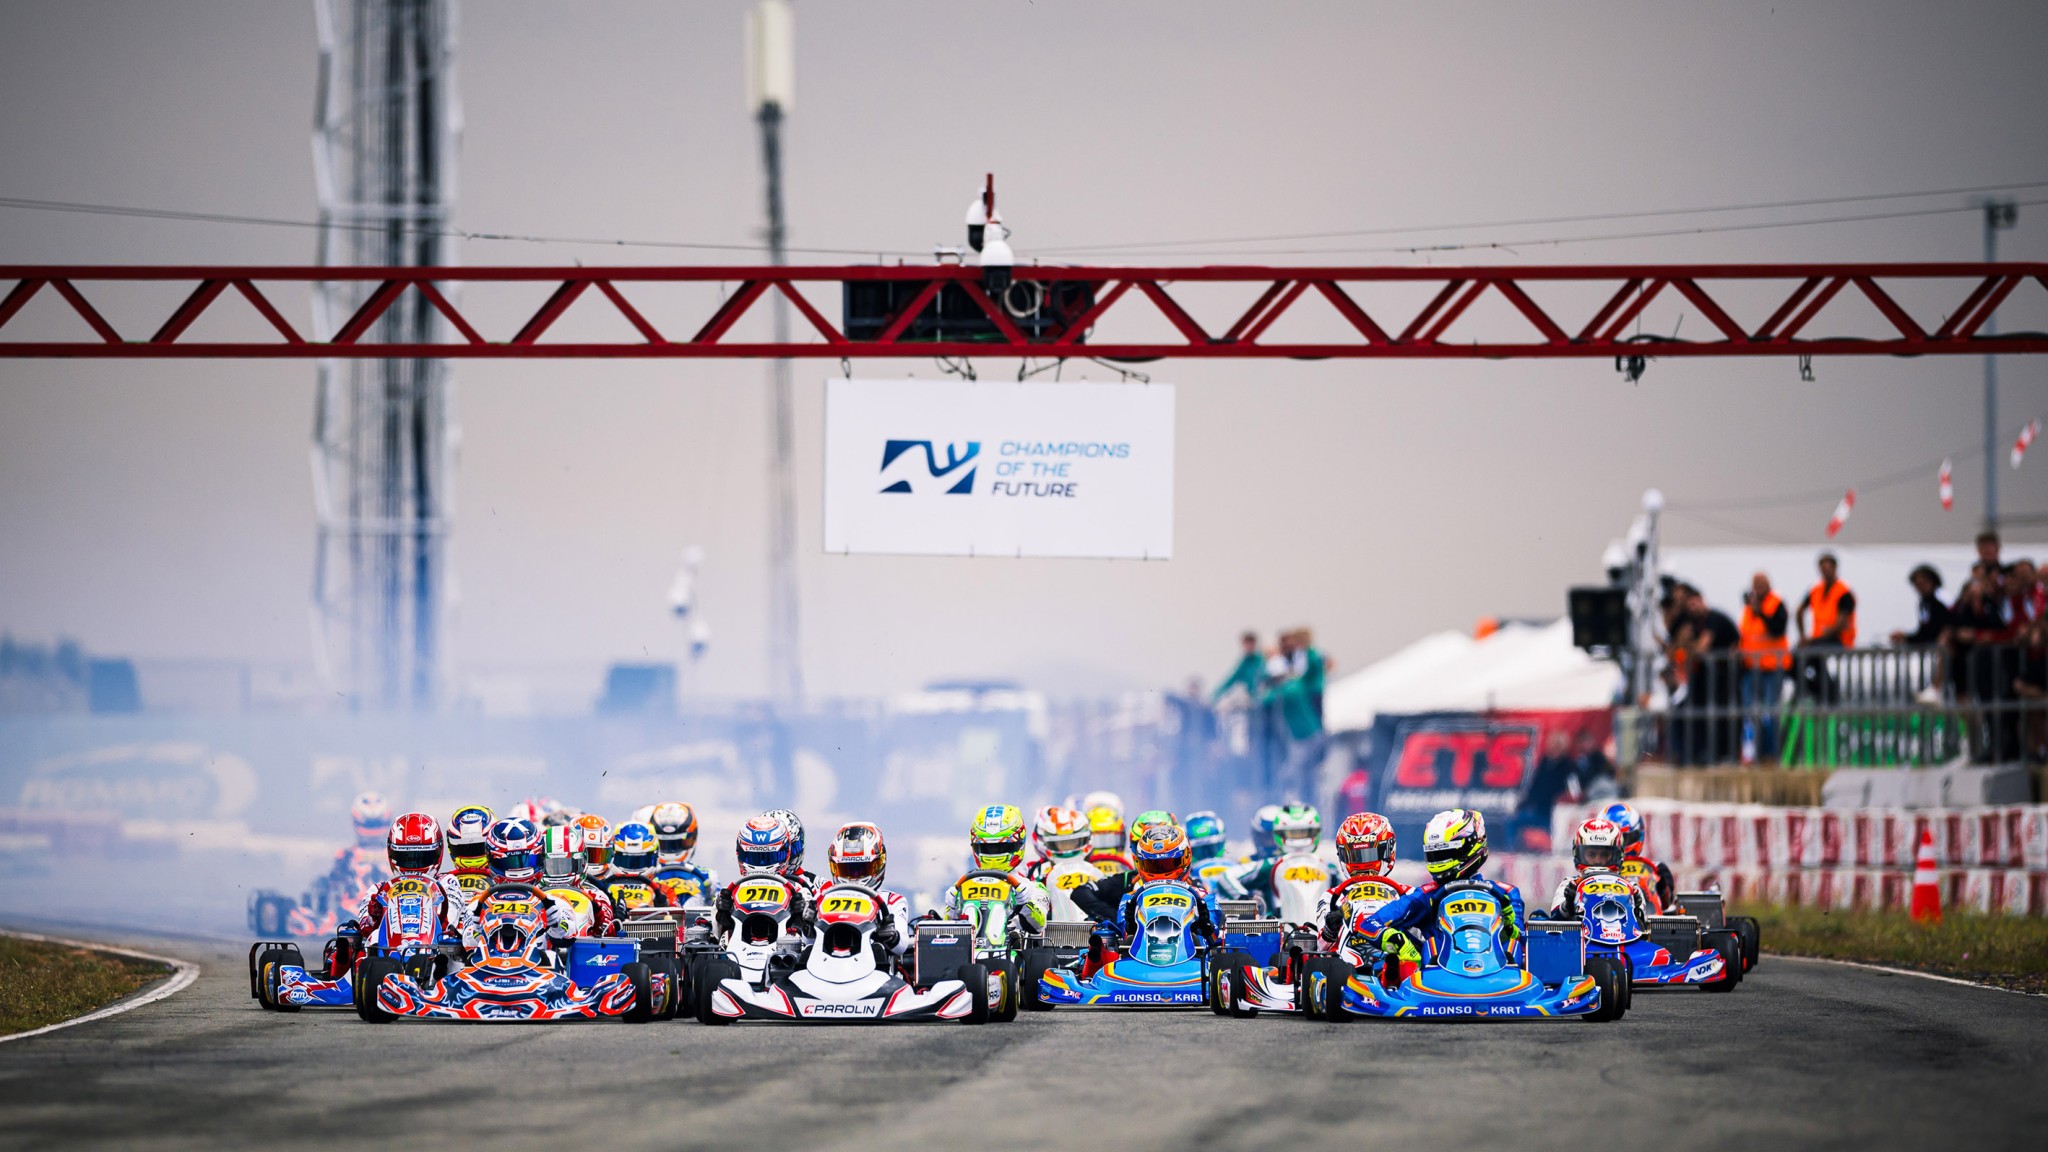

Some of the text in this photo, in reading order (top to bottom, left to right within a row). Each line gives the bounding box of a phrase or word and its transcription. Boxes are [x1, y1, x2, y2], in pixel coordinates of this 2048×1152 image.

[999, 441, 1130, 458] CHAMPIONS
[996, 462, 1071, 477] OF THE
[992, 481, 1077, 497] FUTURE
[1396, 731, 1530, 788] ETS
[756, 834, 767, 842] W
[391, 881, 430, 897] 301
[746, 888, 778, 902] 270
[968, 887, 1001, 899] 290
[1351, 886, 1388, 899] 299
[830, 899, 861, 912] 271
[1149, 897, 1187, 907] 236
[1450, 902, 1487, 914] 307
[493, 903, 529, 914] 243
[1695, 964, 1711, 975] VDK
[1114, 993, 1161, 1002] ALONSO
[814, 1005, 875, 1014] PAROLIN
[1423, 1005, 1521, 1015] ALONSO KART
